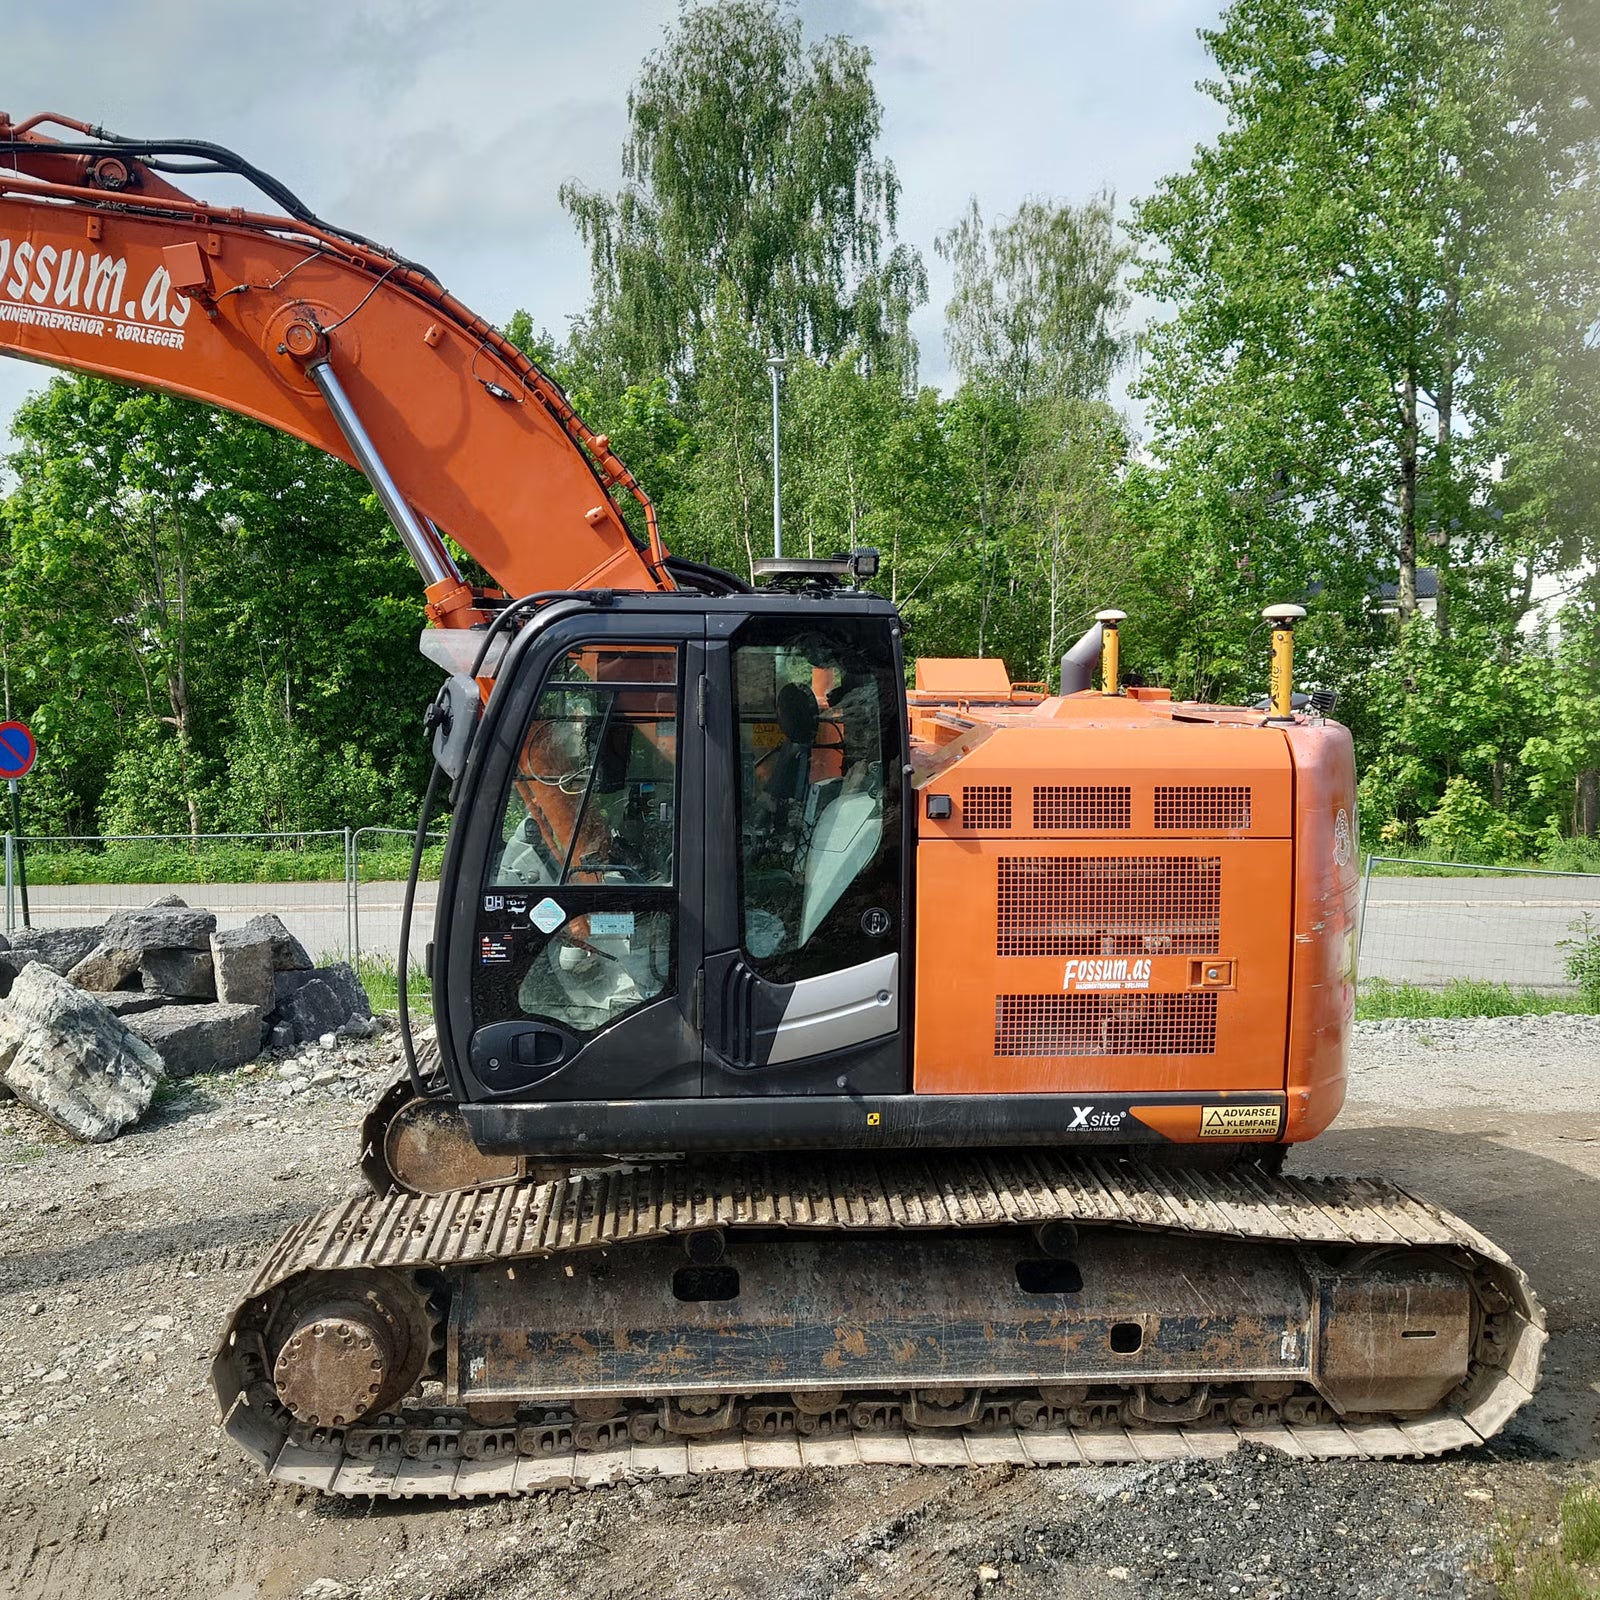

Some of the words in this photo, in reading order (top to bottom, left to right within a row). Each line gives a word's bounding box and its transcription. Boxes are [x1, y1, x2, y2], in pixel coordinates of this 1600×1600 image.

[115, 325, 184, 350] RØRLEGGER
[1063, 959, 1152, 990] Fossum.as
[1223, 1108, 1278, 1117] ADVARSEL
[1227, 1119, 1278, 1127] KLEMFARE
